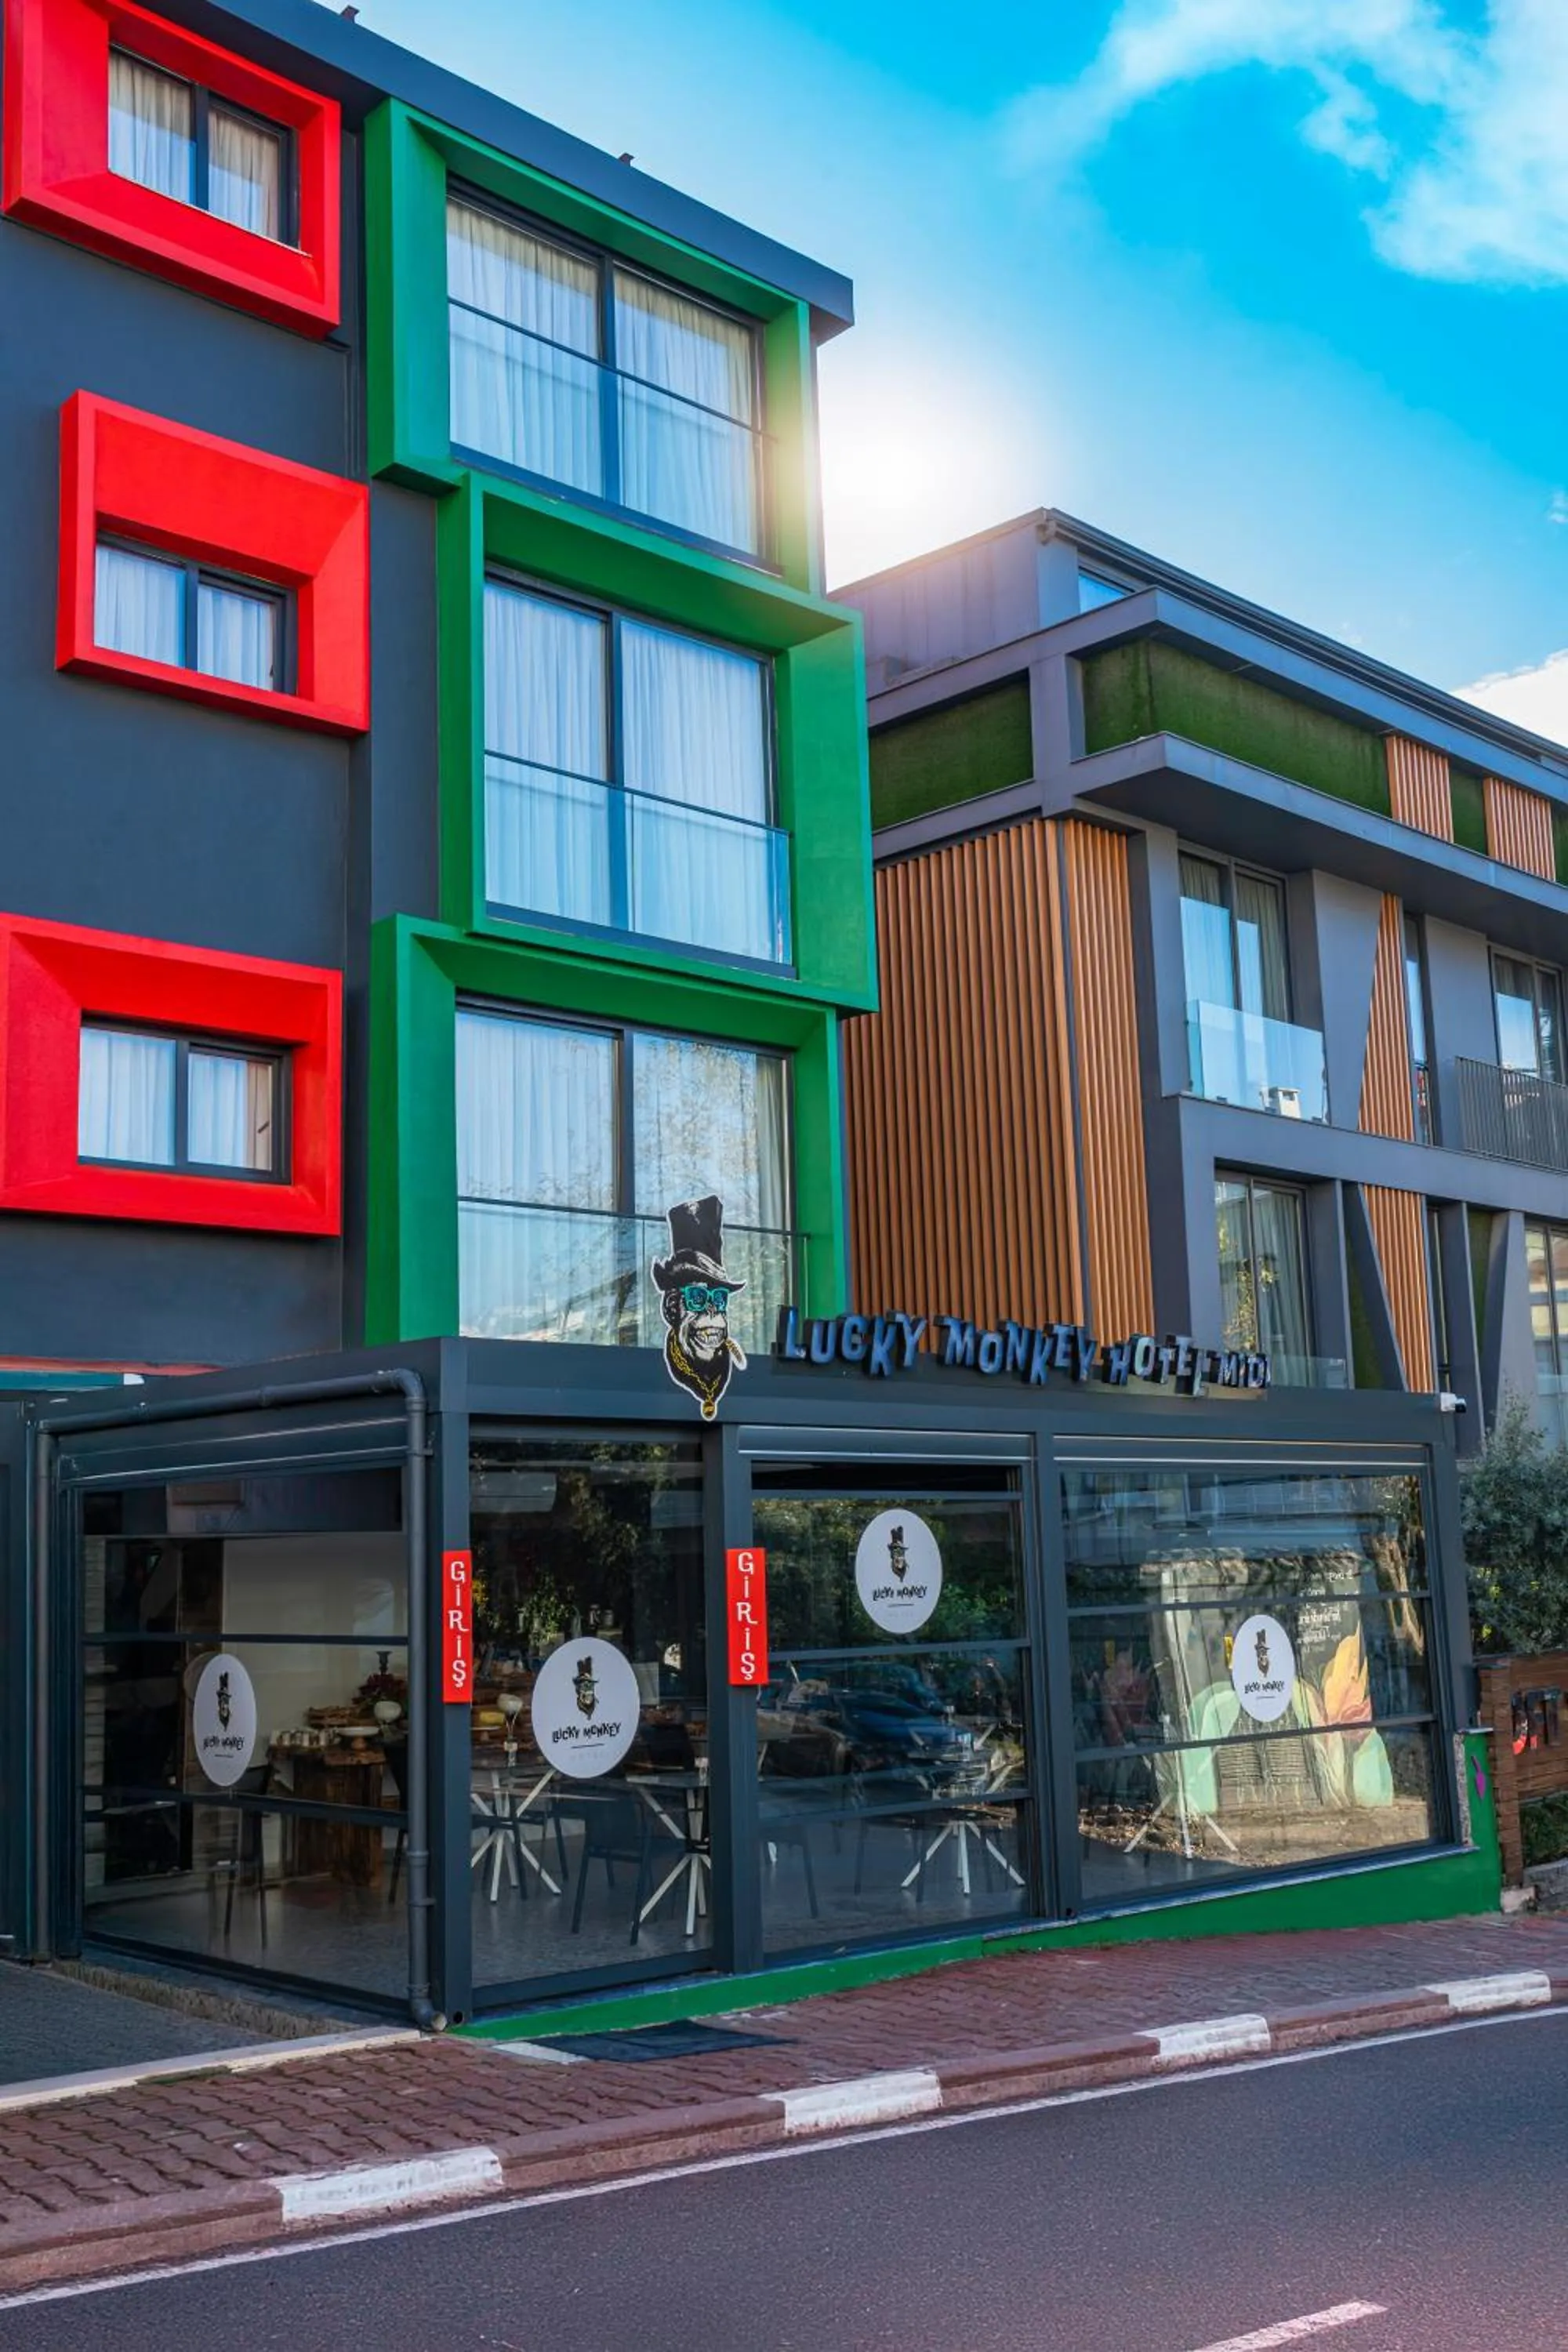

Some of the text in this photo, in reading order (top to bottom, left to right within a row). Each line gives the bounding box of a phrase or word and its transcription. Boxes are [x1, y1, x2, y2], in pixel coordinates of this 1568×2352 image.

[781, 1305, 927, 1377] LUCKY
[941, 1316, 1097, 1386] MONKEY
[1106, 1335, 1210, 1397] HOTEL
[736, 1552, 758, 1680] GİRİŞ
[552, 1722, 622, 1743] LUCKY MONKEY
